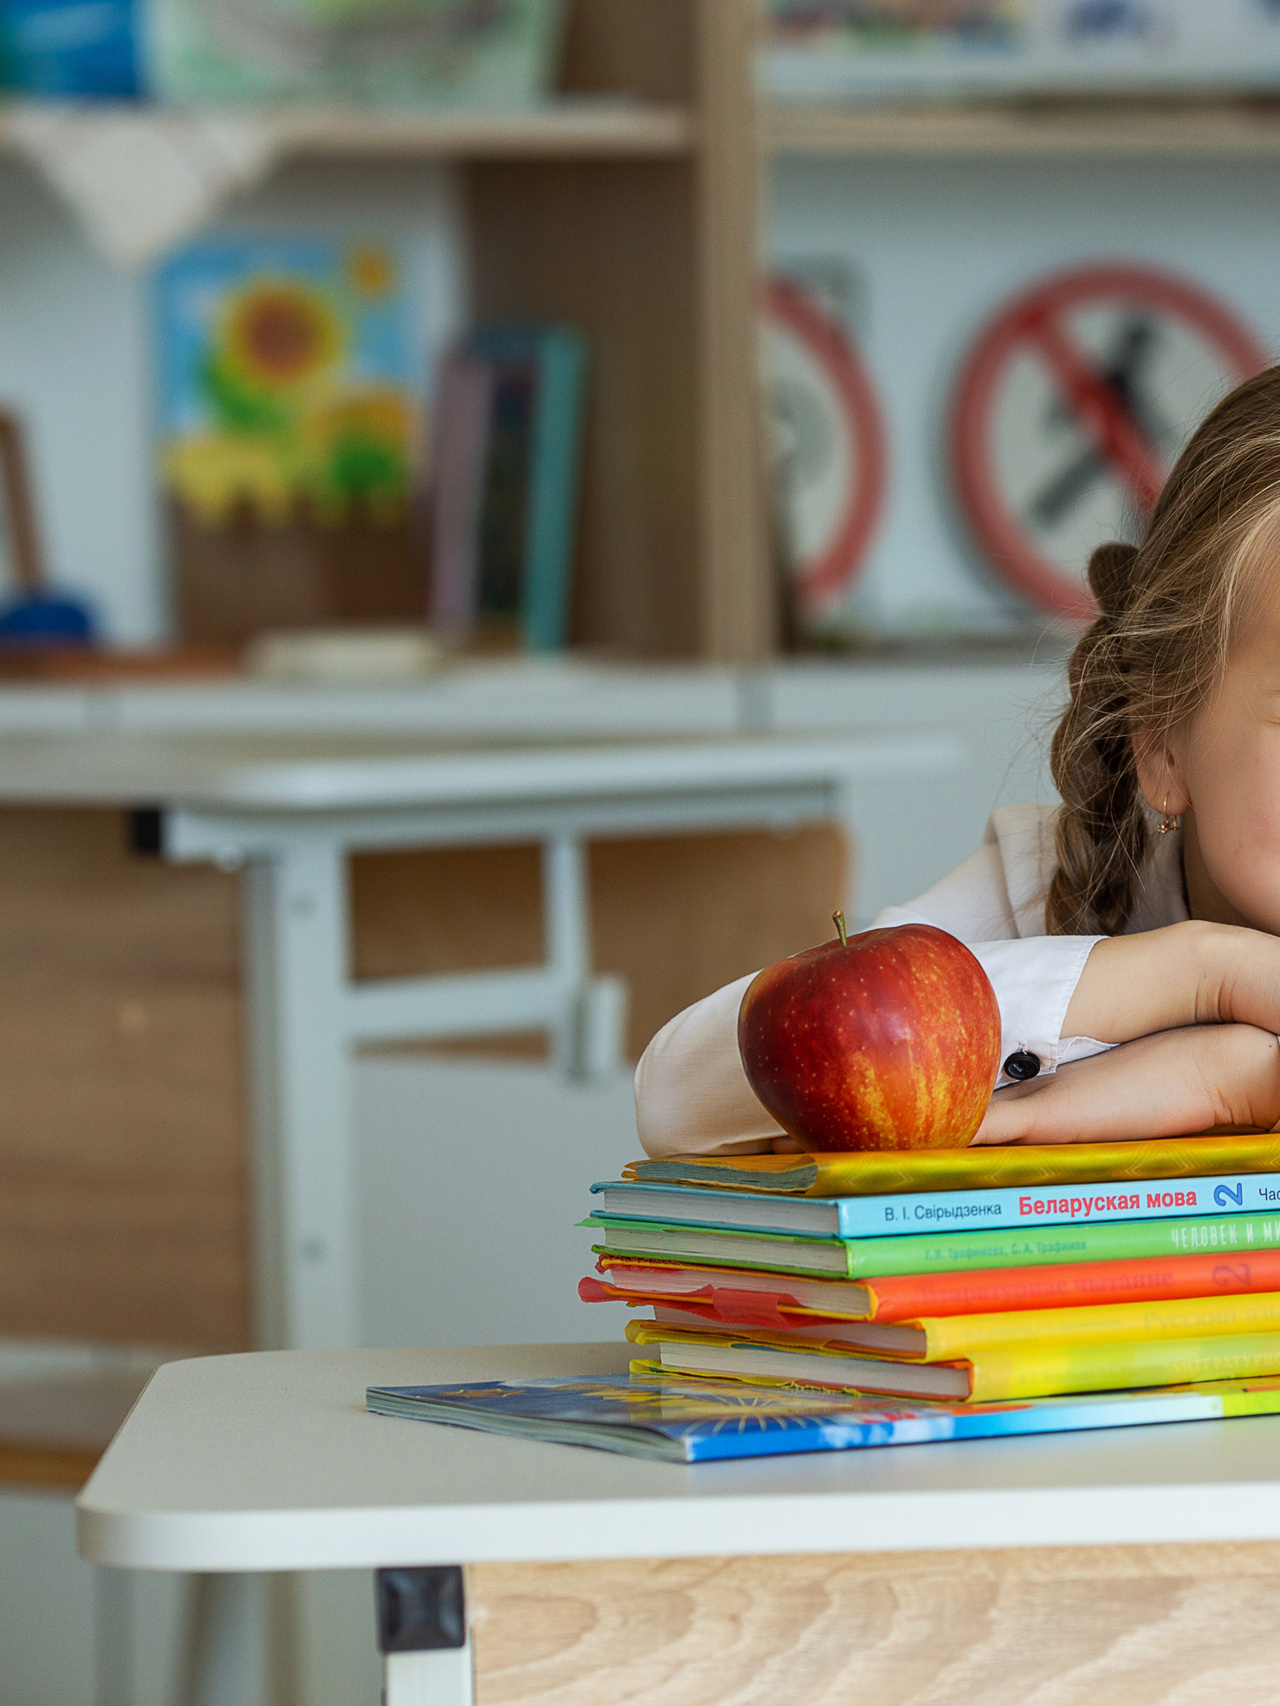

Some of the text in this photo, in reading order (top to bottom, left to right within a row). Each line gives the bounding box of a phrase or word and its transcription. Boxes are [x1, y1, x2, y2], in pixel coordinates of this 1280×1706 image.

[884, 1207, 899, 1222] В.
[914, 1203, 1002, 1222] Свірыдзенка
[1018, 1193, 1141, 1218] Беларуская
[1147, 1190, 1197, 1210] мова
[1213, 1182, 1243, 1208] 2
[1171, 1223, 1238, 1250] ЧЕЛОВЕК
[1246, 1222, 1255, 1244] И
[1211, 1263, 1252, 1288] 2
